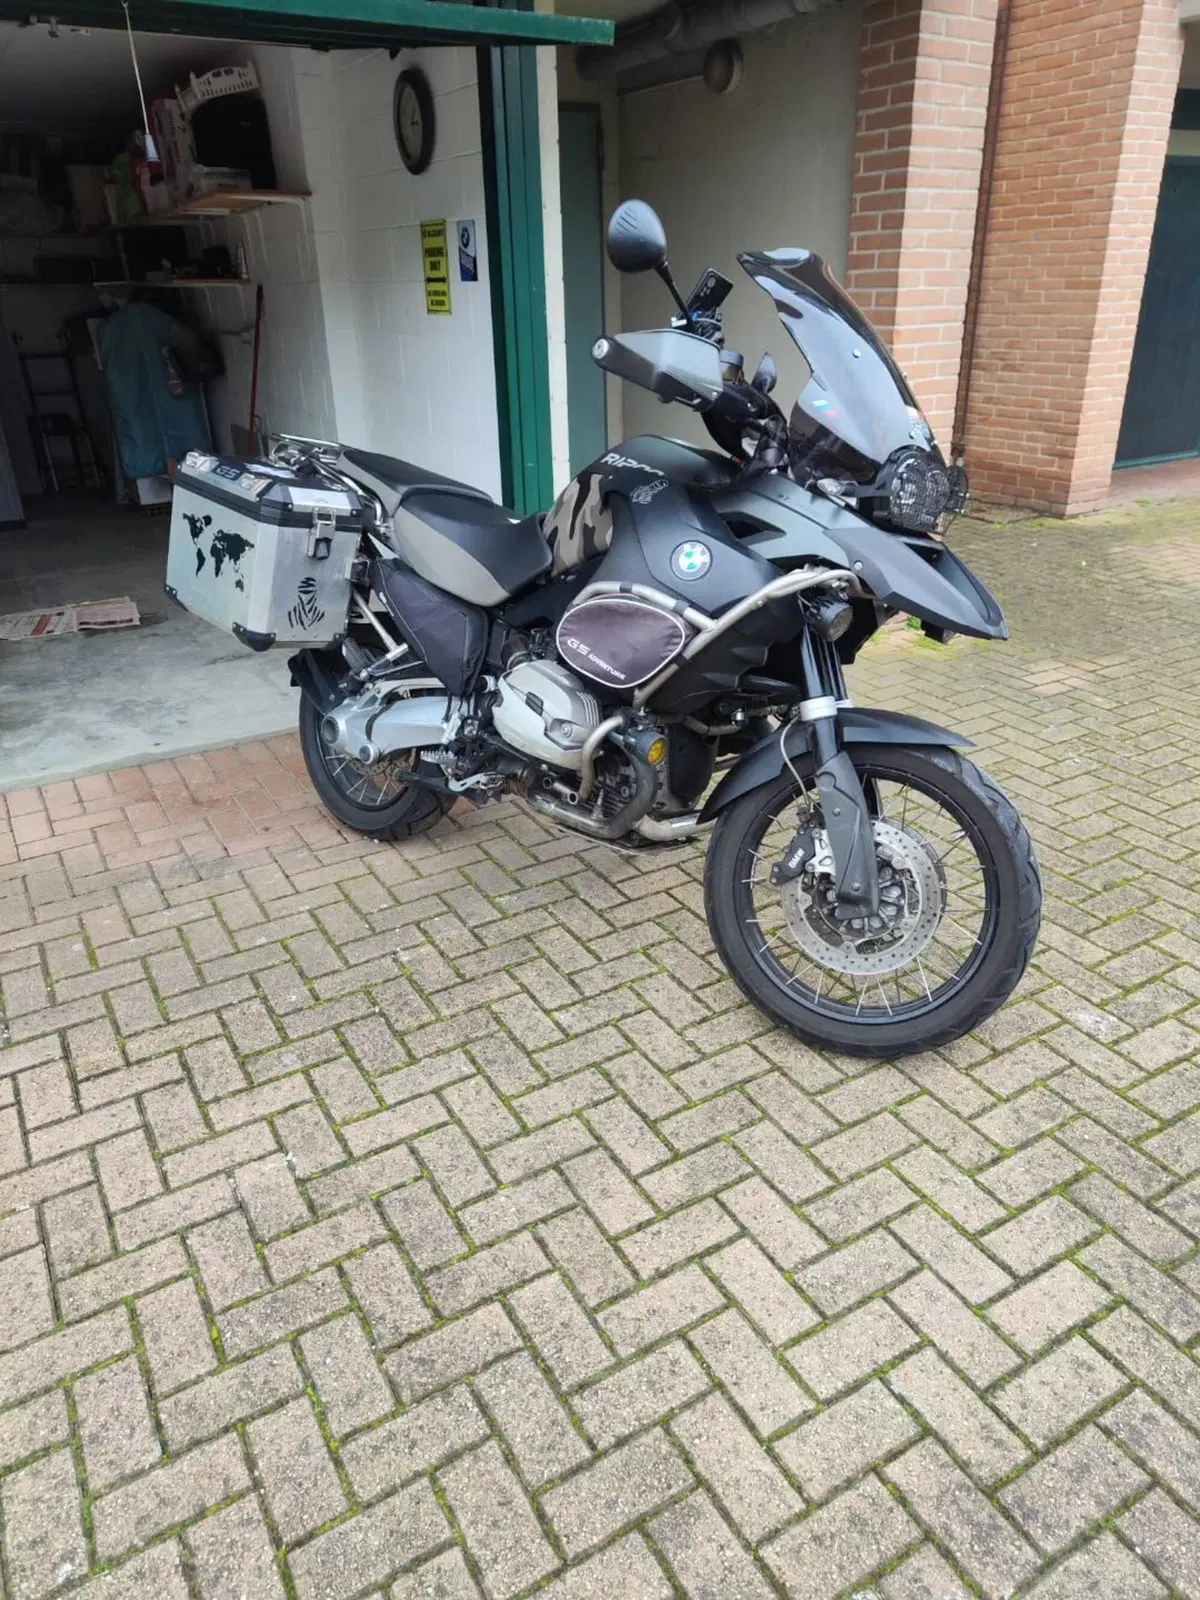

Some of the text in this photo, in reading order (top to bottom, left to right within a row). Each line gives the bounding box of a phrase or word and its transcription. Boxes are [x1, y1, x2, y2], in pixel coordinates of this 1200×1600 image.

[216, 465, 241, 479] GS
[567, 637, 627, 681] GS ADVENTURE
[788, 847, 805, 869] BMW
